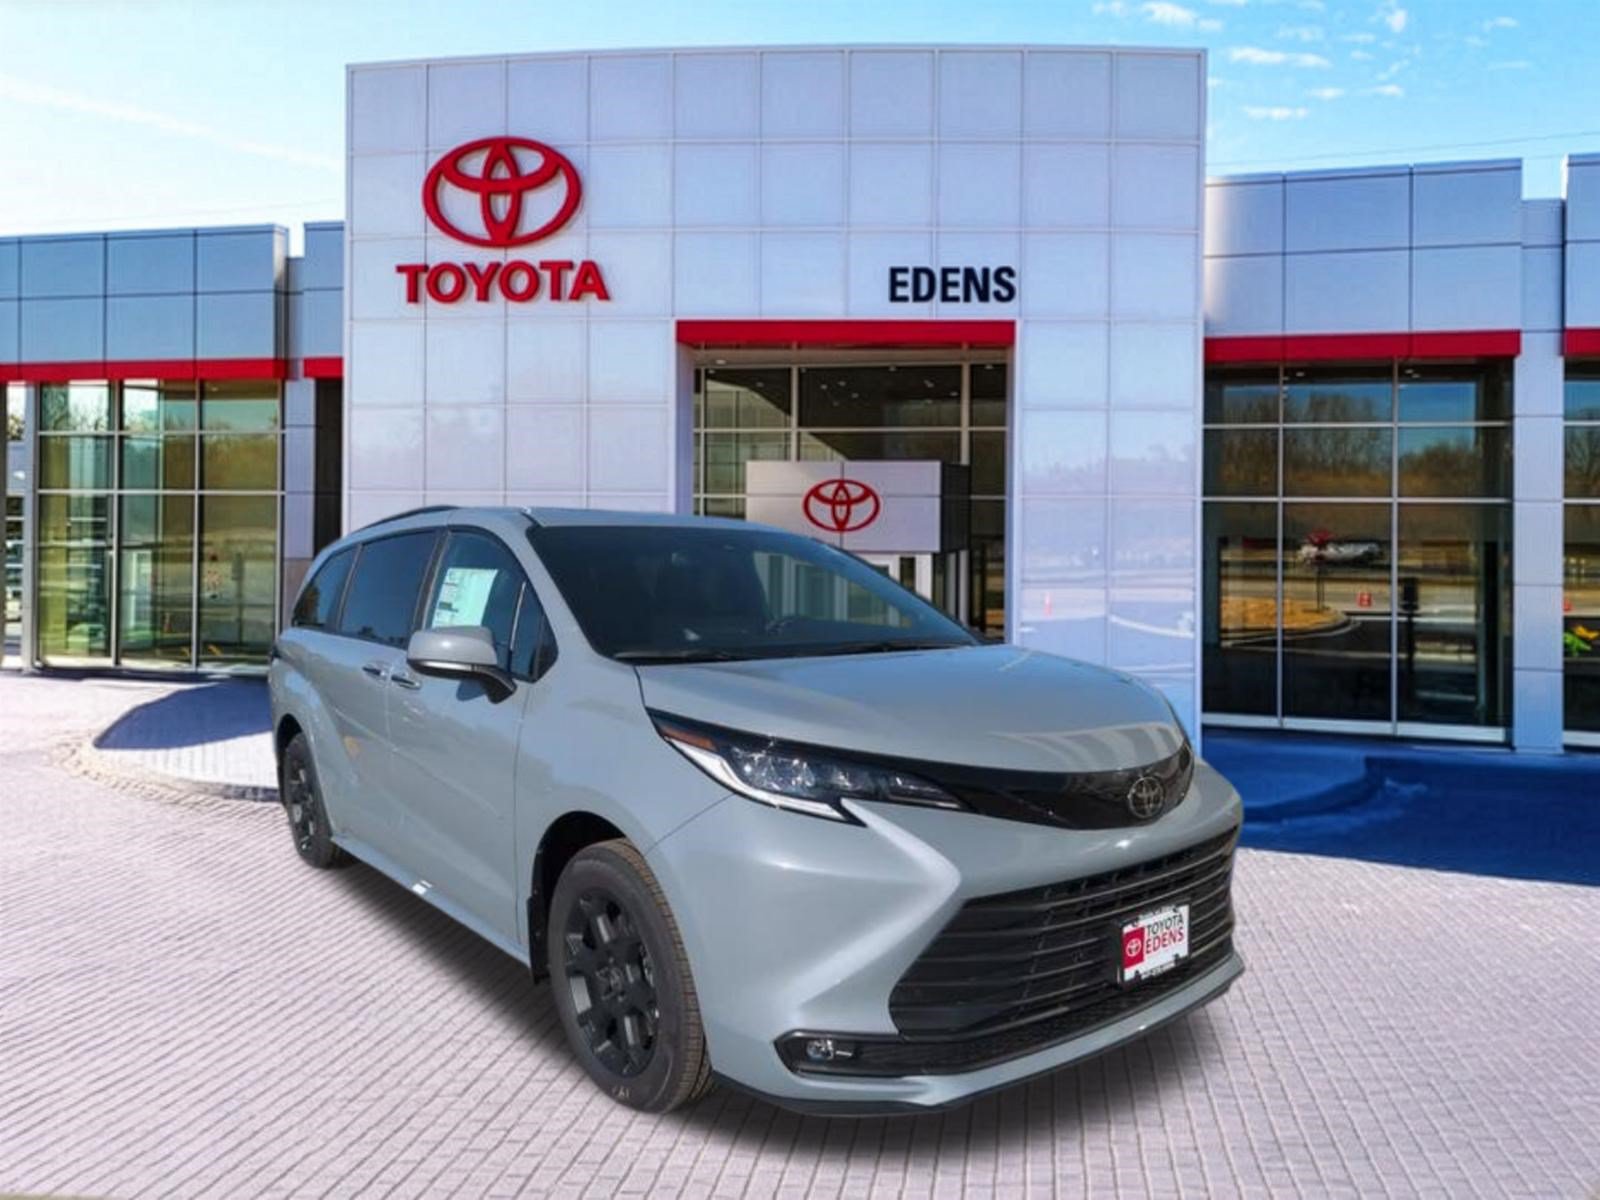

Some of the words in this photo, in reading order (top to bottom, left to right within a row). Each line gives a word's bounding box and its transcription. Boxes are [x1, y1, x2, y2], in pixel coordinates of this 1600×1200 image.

[396, 260, 610, 304] TOYOTA
[889, 266, 1017, 303] EDENS
[1146, 914, 1184, 937] TOYOTA
[1146, 926, 1184, 954] EDENS
